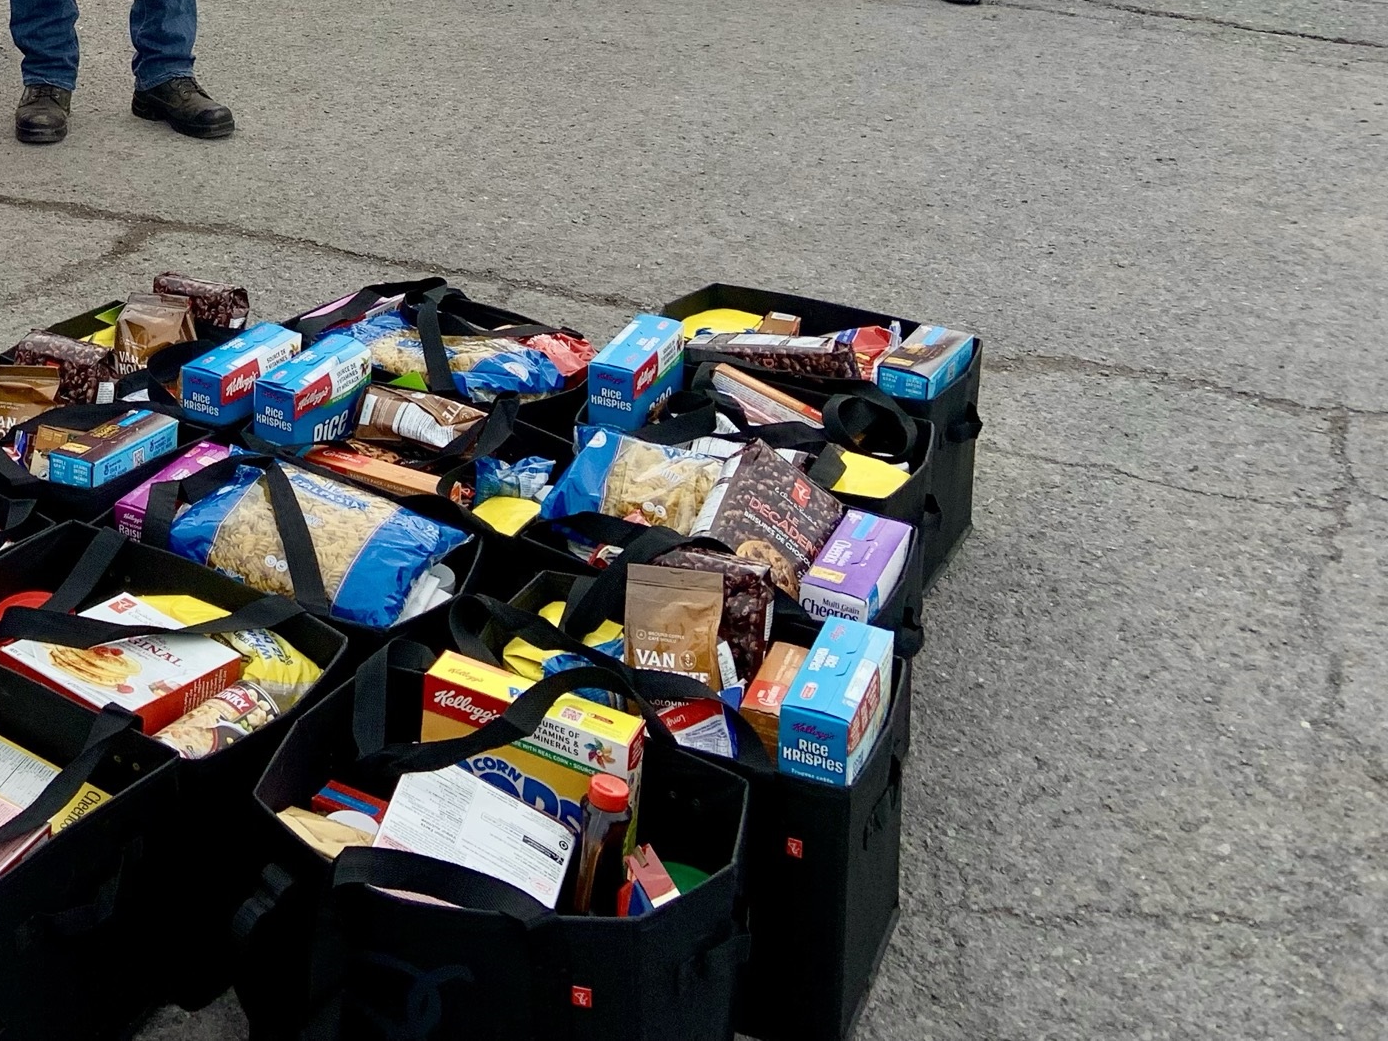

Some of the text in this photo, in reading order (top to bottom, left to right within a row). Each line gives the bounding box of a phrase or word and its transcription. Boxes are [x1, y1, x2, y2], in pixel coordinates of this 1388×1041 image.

[635, 648, 676, 669] VAN
[532, 733, 580, 757] MINERALS
[567, 730, 580, 740] OF
[473, 756, 522, 784] CORN
[59, 790, 102, 829] Cheerios
